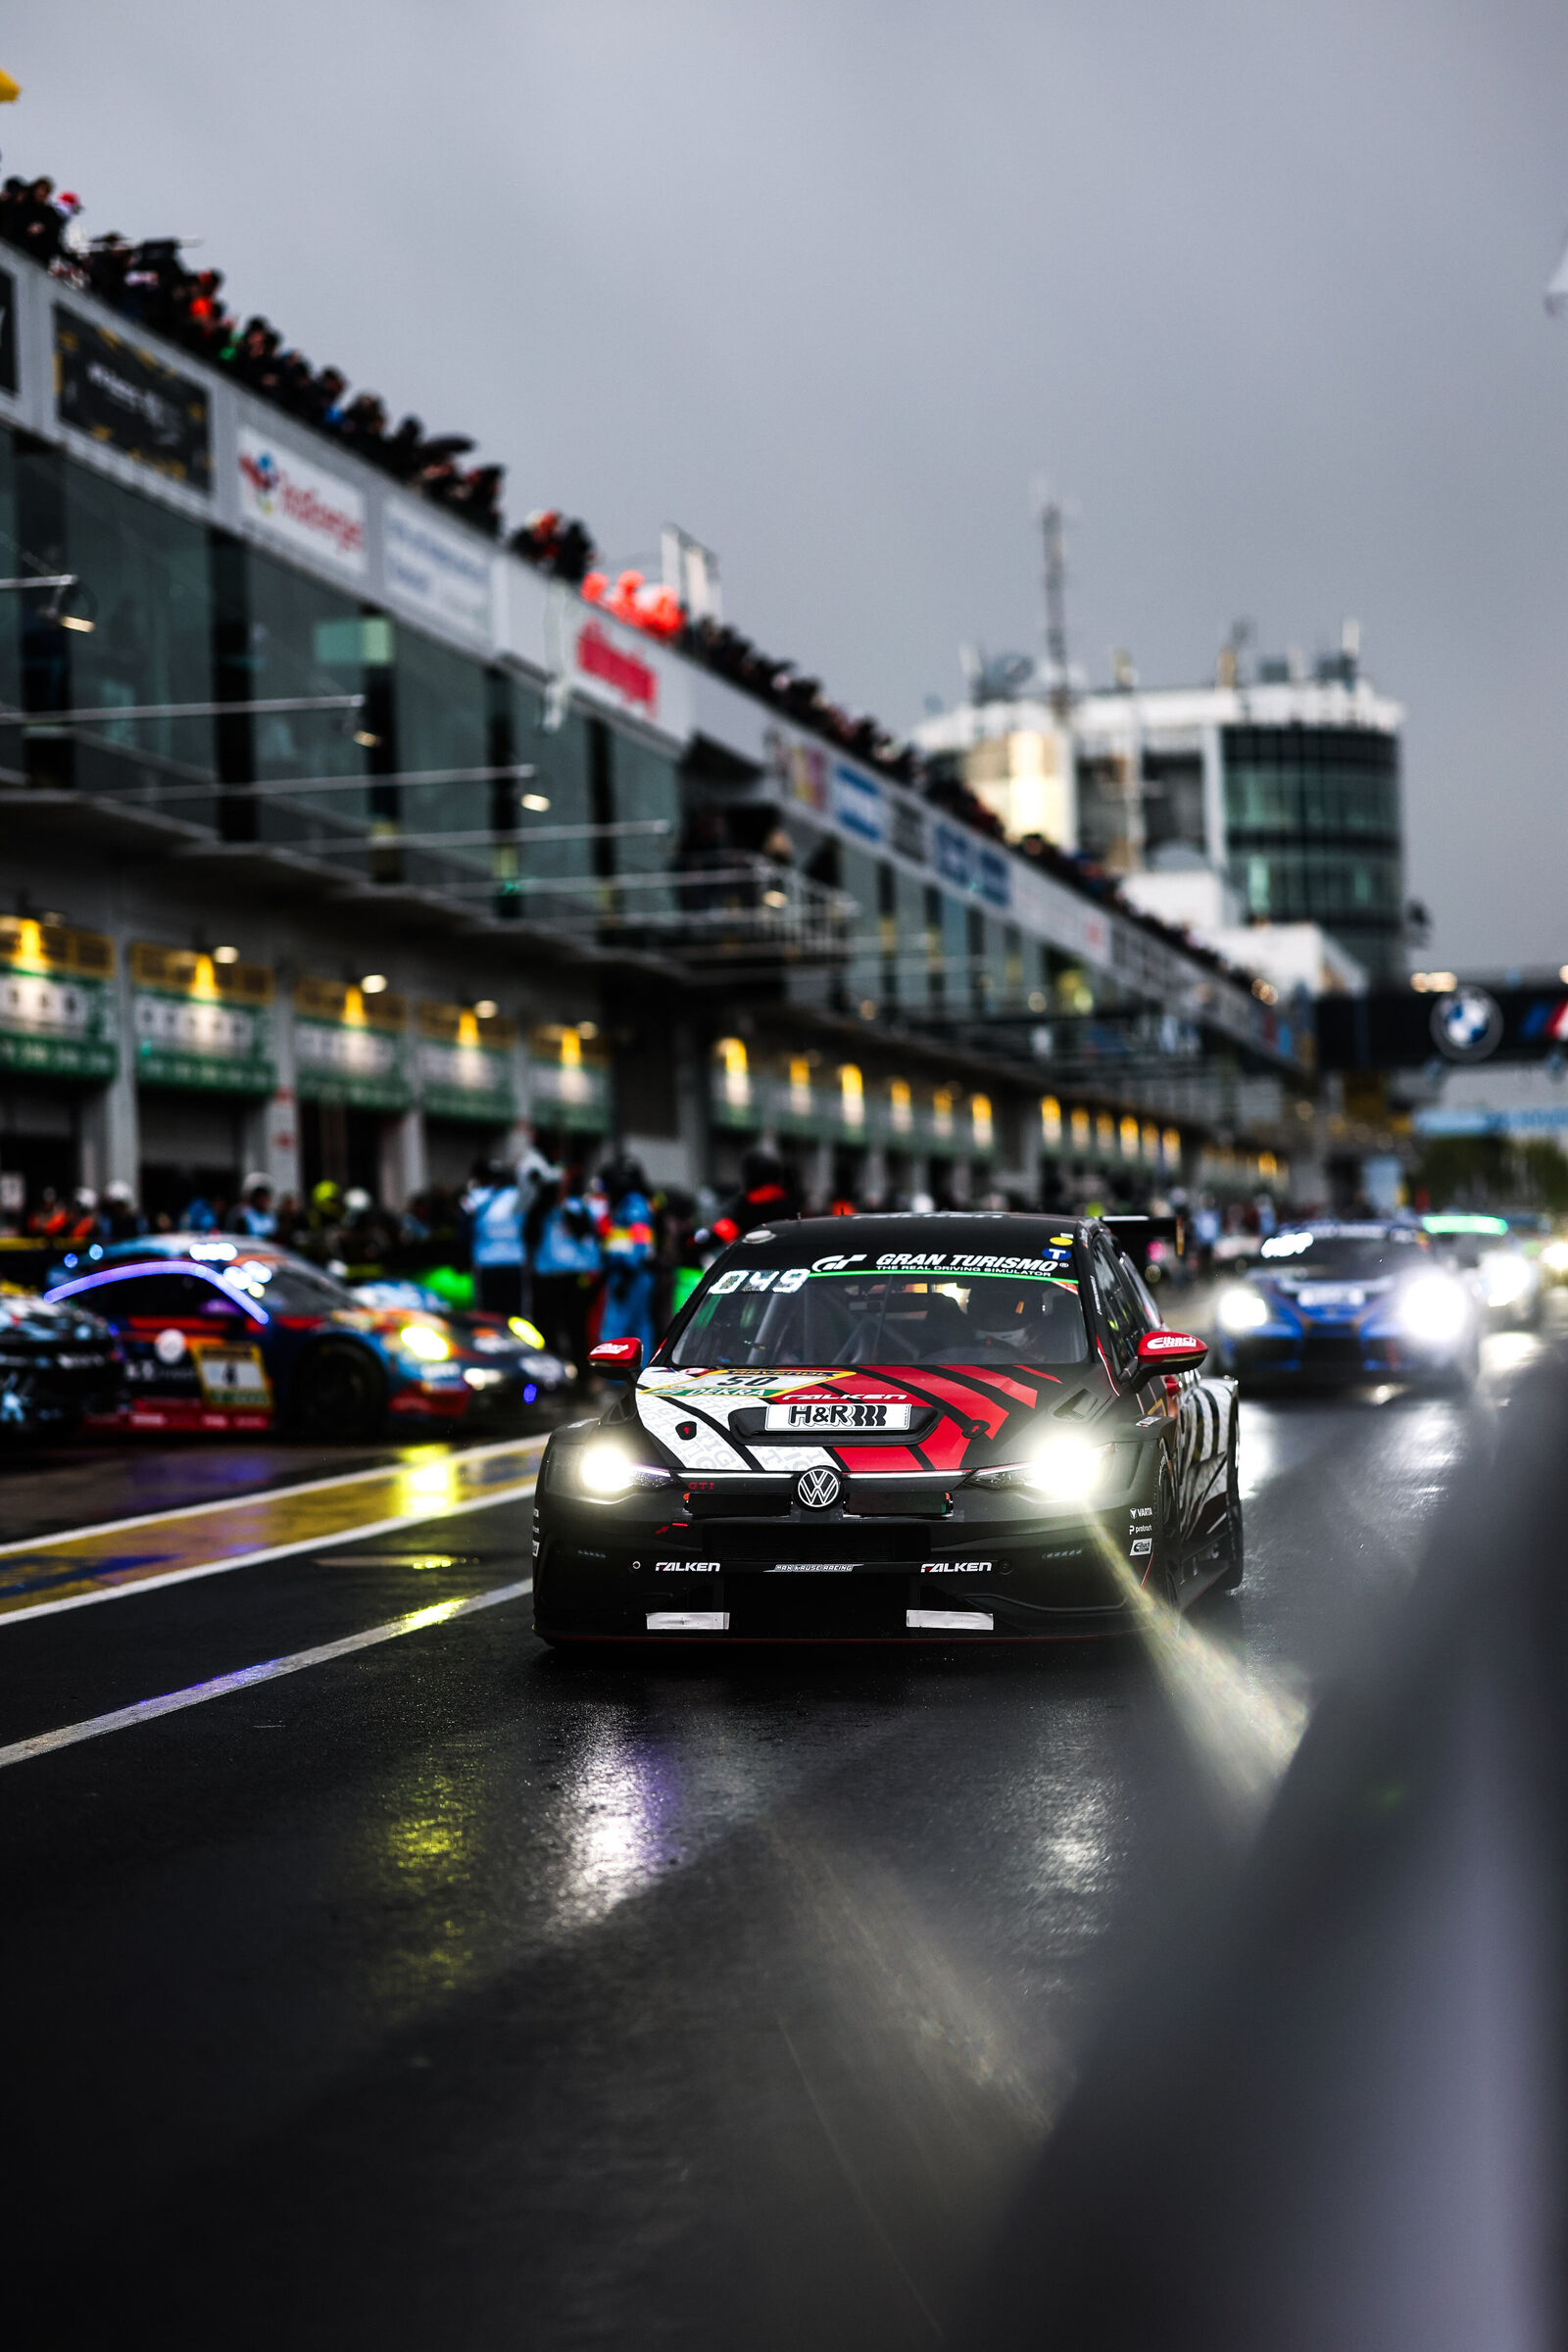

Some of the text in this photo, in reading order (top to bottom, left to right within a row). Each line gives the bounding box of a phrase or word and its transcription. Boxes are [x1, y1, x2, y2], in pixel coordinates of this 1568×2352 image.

[875, 1252, 1060, 1272] GRAN TURISMO
[983, 1266, 1053, 1278] SIMULATOR
[708, 1268, 811, 1295] 049
[716, 1376, 780, 1387] 50
[685, 1388, 765, 1396] DEKRA
[789, 1404, 853, 1426] H&R
[687, 1481, 715, 1491] GTI
[1137, 1507, 1153, 1517] VARTA
[655, 1561, 721, 1572] FALKEN
[920, 1561, 993, 1573] FALKEN
